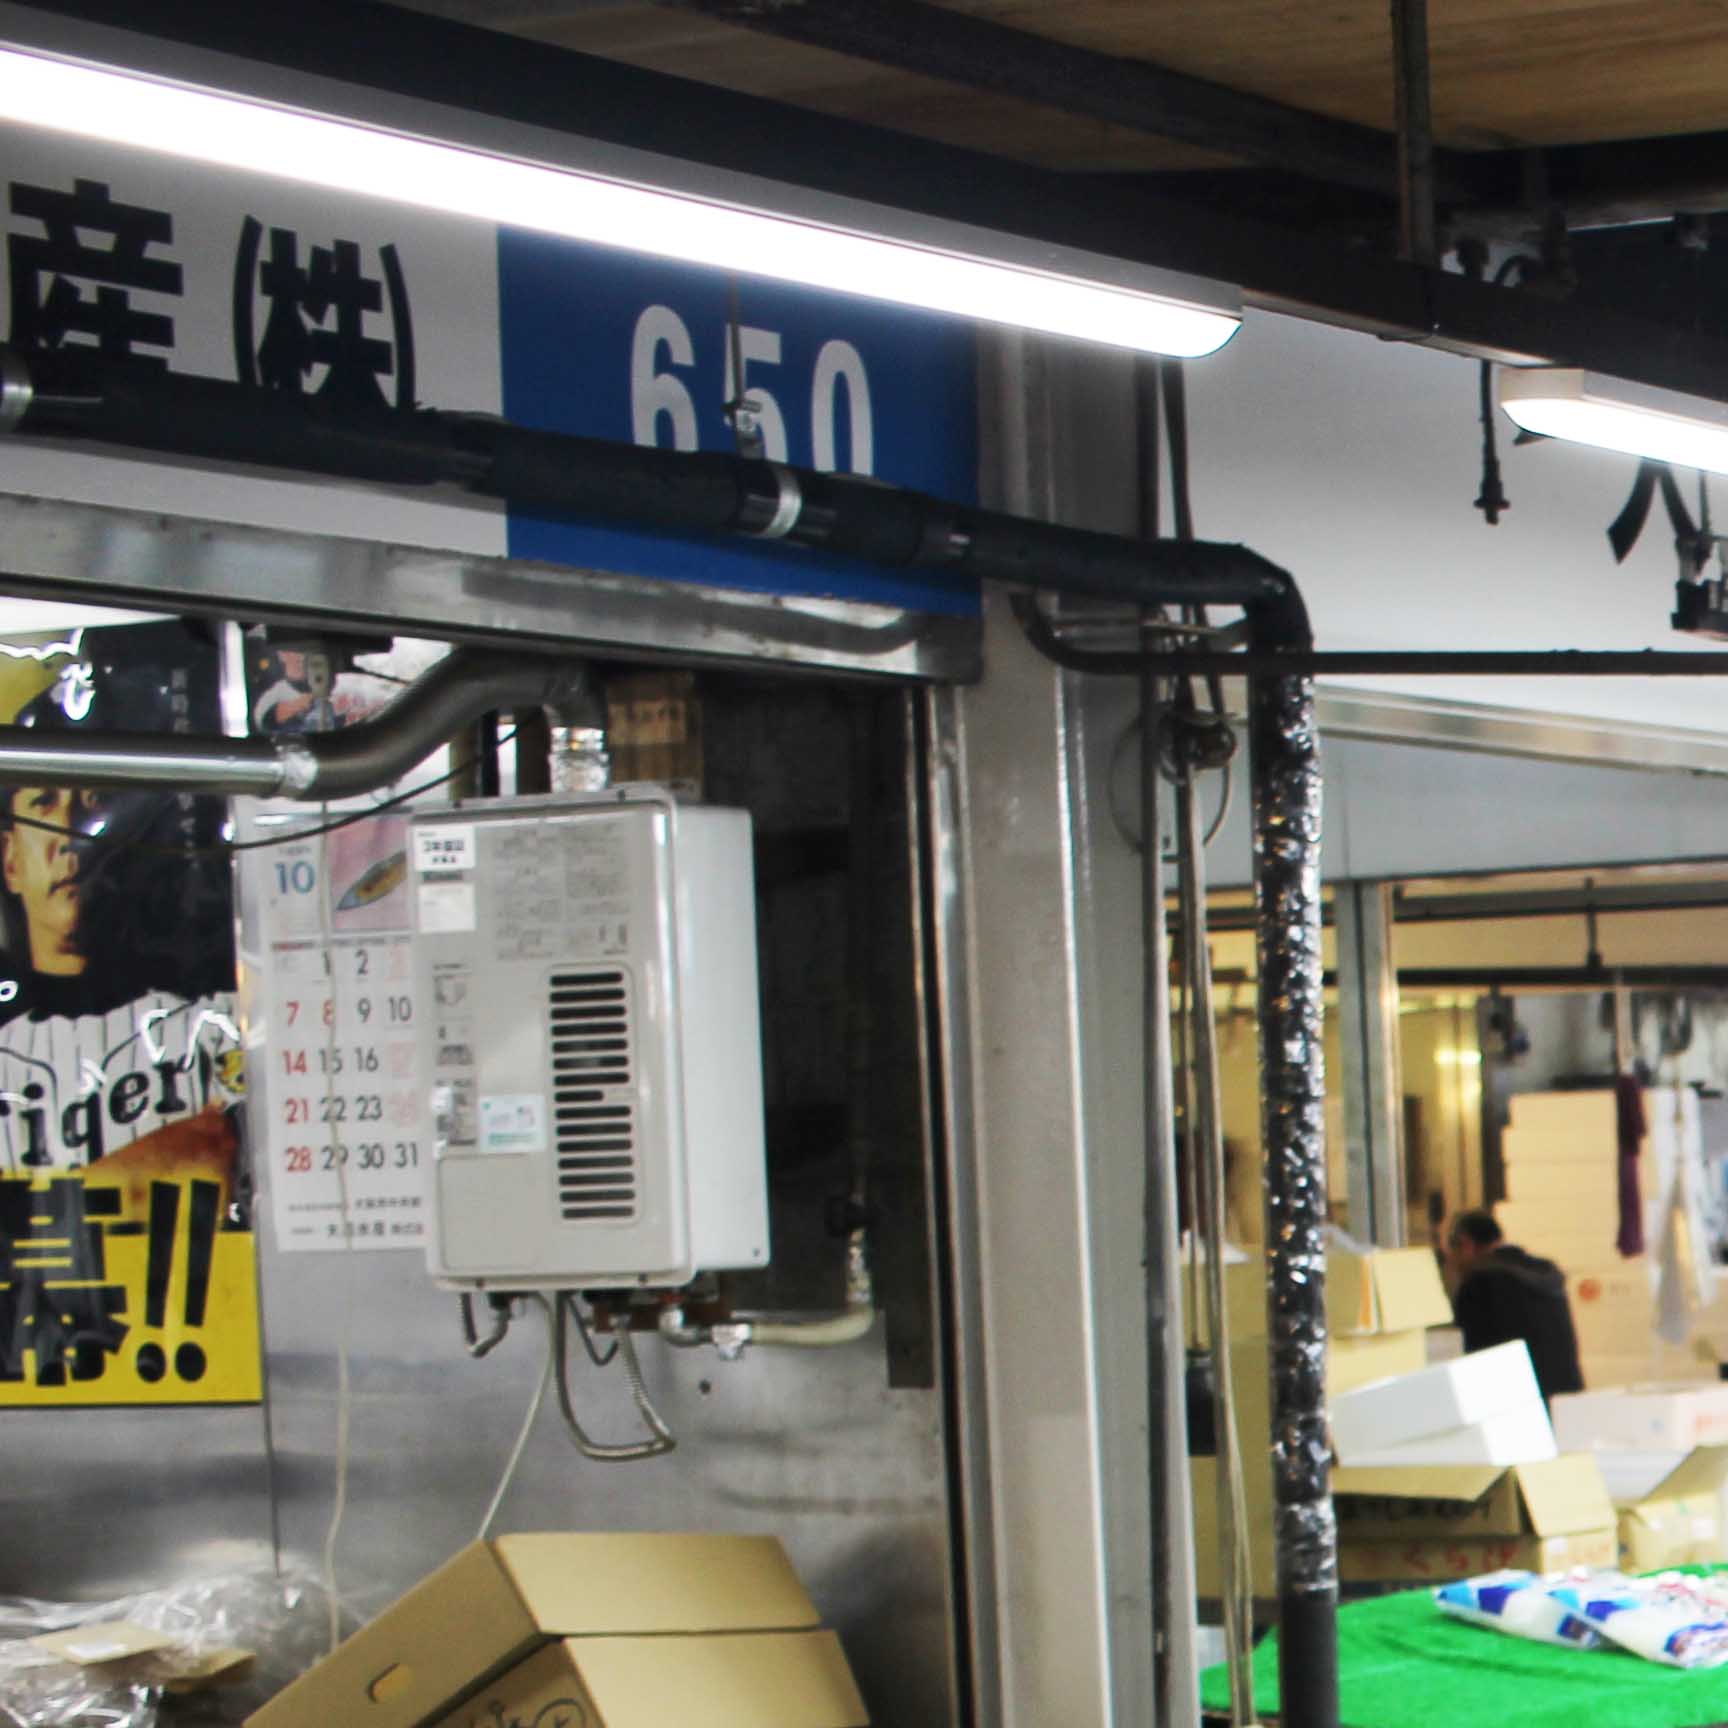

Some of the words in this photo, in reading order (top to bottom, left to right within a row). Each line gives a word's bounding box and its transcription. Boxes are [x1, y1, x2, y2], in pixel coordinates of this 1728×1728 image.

[630, 304, 873, 475] 650
[275, 860, 317, 895] 10
[357, 997, 371, 1024] 9
[388, 996, 413, 1022] 10
[283, 1049, 308, 1076] 14
[354, 1047, 380, 1073] 16
[285, 1097, 310, 1125] 21
[355, 1095, 383, 1122] 23
[285, 1146, 313, 1174] 28
[357, 1143, 386, 1169] 30
[393, 1141, 419, 1168] 31
